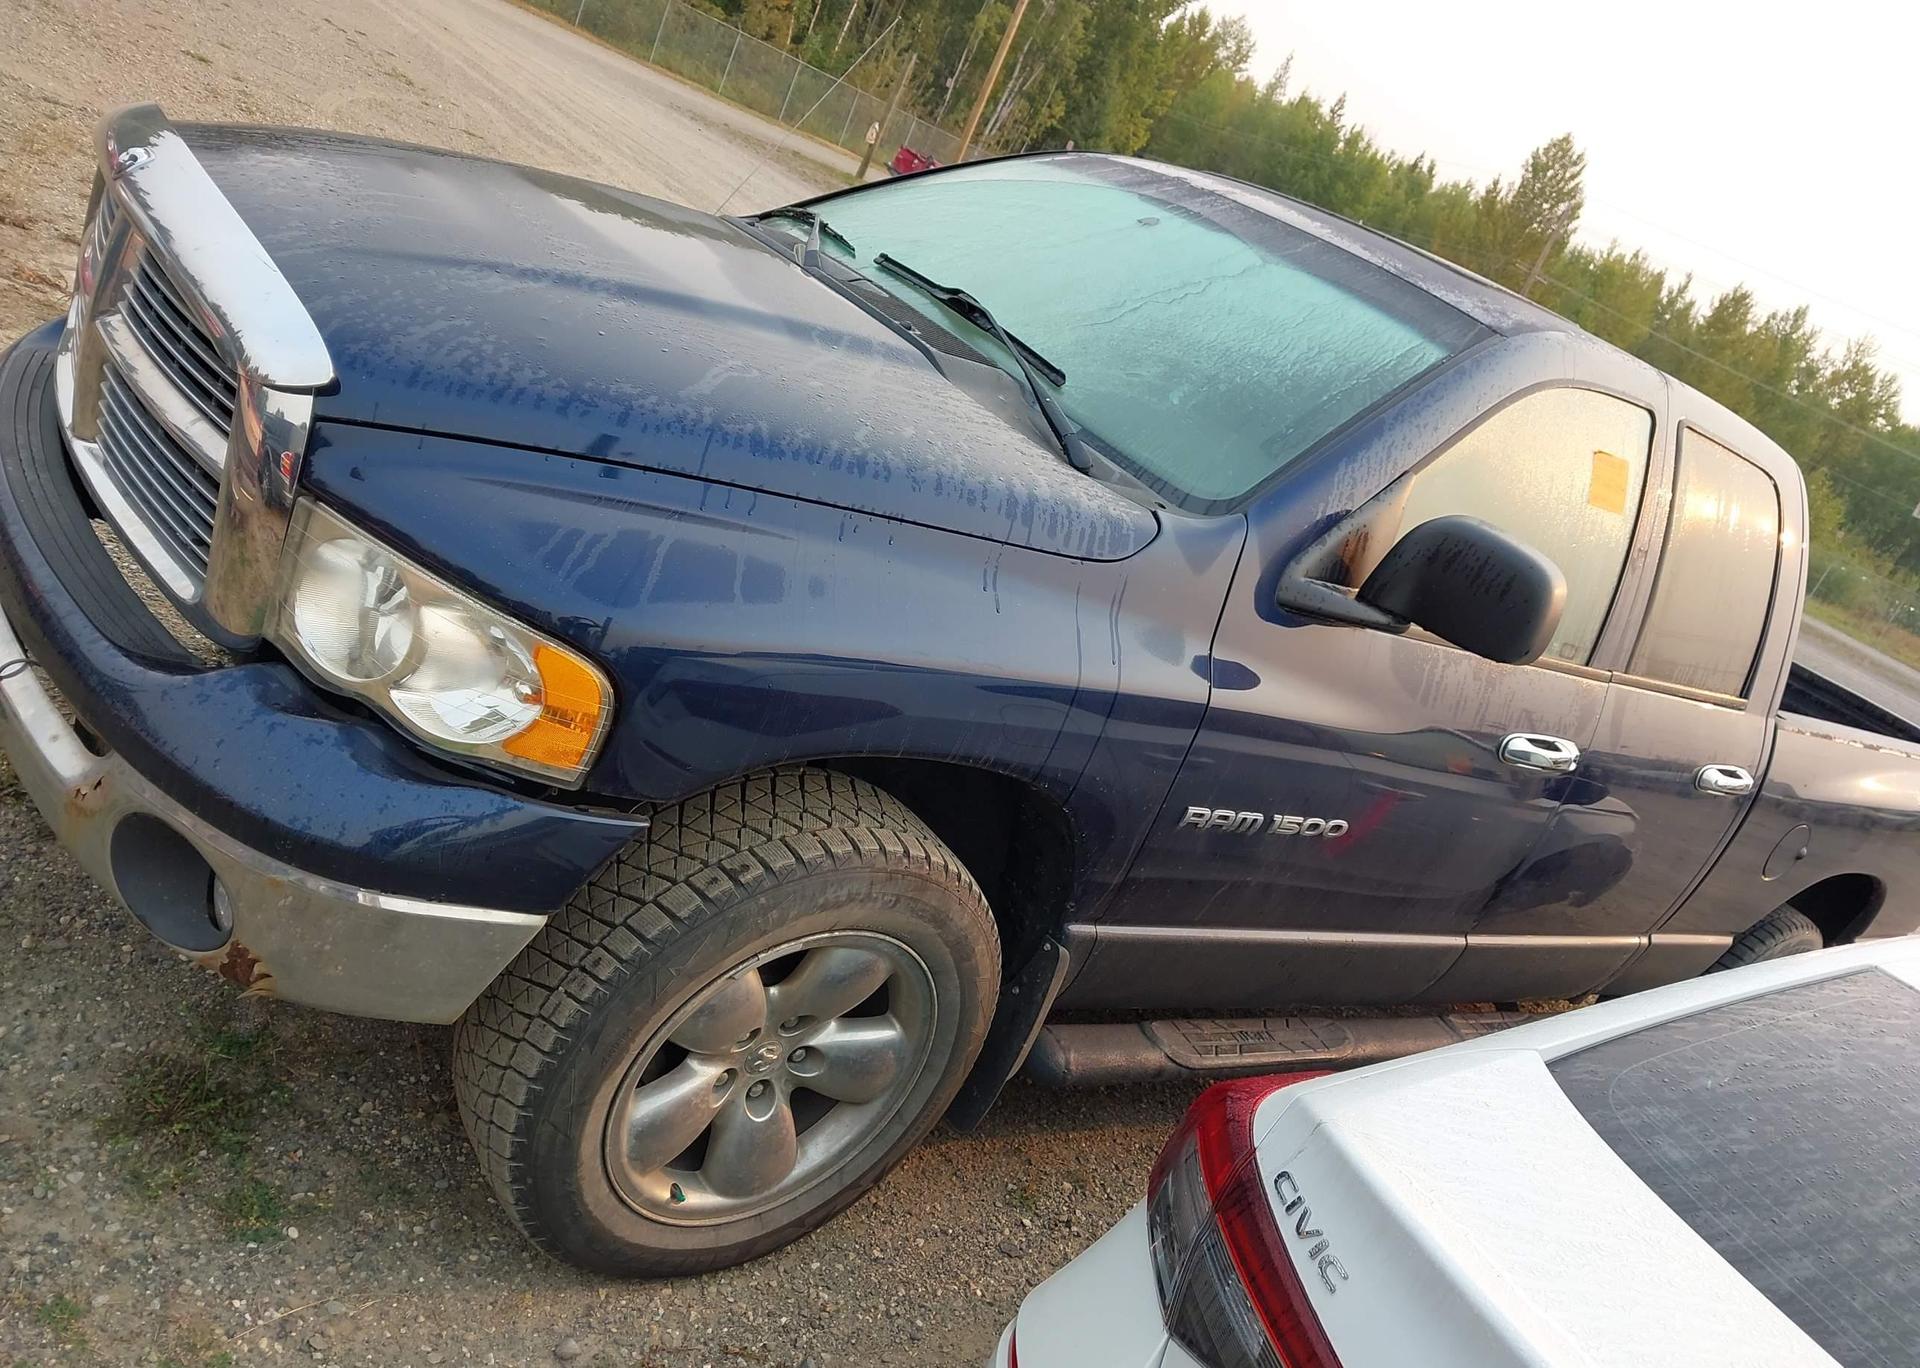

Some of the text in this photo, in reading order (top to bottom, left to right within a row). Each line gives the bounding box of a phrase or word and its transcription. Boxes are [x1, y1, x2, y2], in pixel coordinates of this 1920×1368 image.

[1179, 805, 1350, 838] RAM 1500
[1273, 1170, 1349, 1294] CIVIC
